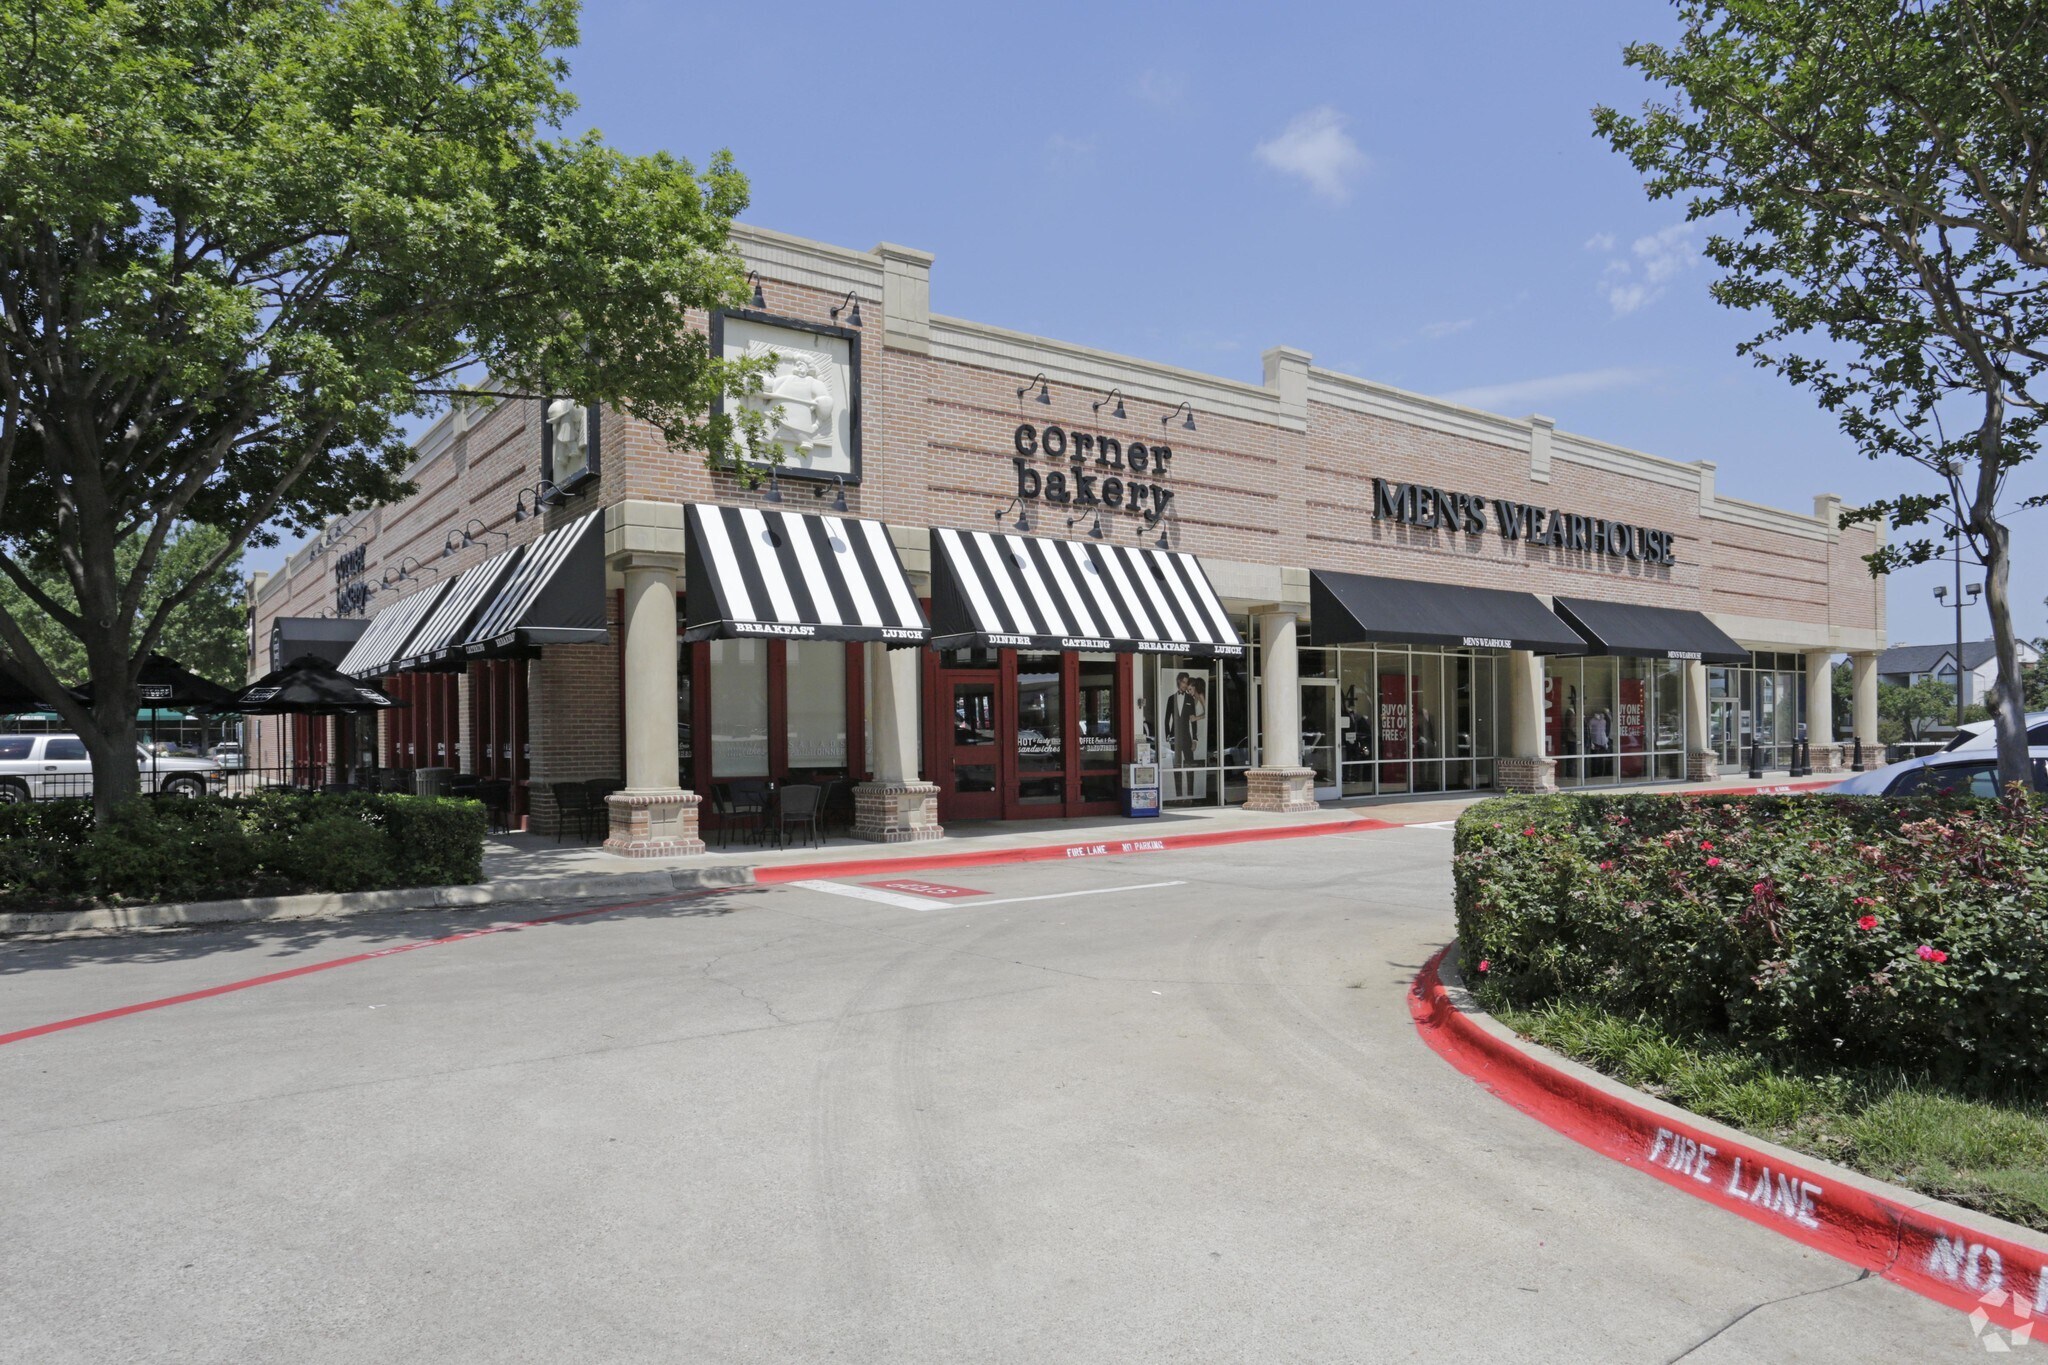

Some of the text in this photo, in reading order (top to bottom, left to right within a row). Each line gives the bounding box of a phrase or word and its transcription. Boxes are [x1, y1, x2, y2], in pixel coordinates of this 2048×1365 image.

[1014, 424, 1172, 474] corner
[1013, 457, 1174, 522] bakery
[1371, 478, 1675, 566] MEN'S WEARHOUSE
[735, 622, 923, 639] BREAKFAST LUNCH
[988, 634, 1242, 655] DINNER CATERING BREAKFAST LUNCH
[1480, 638, 1512, 648] WEARHOUSE
[1382, 704, 1396, 716] BUY
[1626, 704, 1640, 715] ONE
[1382, 717, 1395, 729] GET
[1626, 715, 1640, 726] ONE
[1382, 729, 1399, 741] FREE
[1017, 737, 1032, 746] HOT
[1017, 744, 1060, 753] sandwiches
[1066, 840, 1164, 857] FIRE LANE NO PARKING
[1648, 1126, 1717, 1184] FIRE
[1724, 1156, 1823, 1229] LANE
[1926, 1228, 2003, 1292] NO
